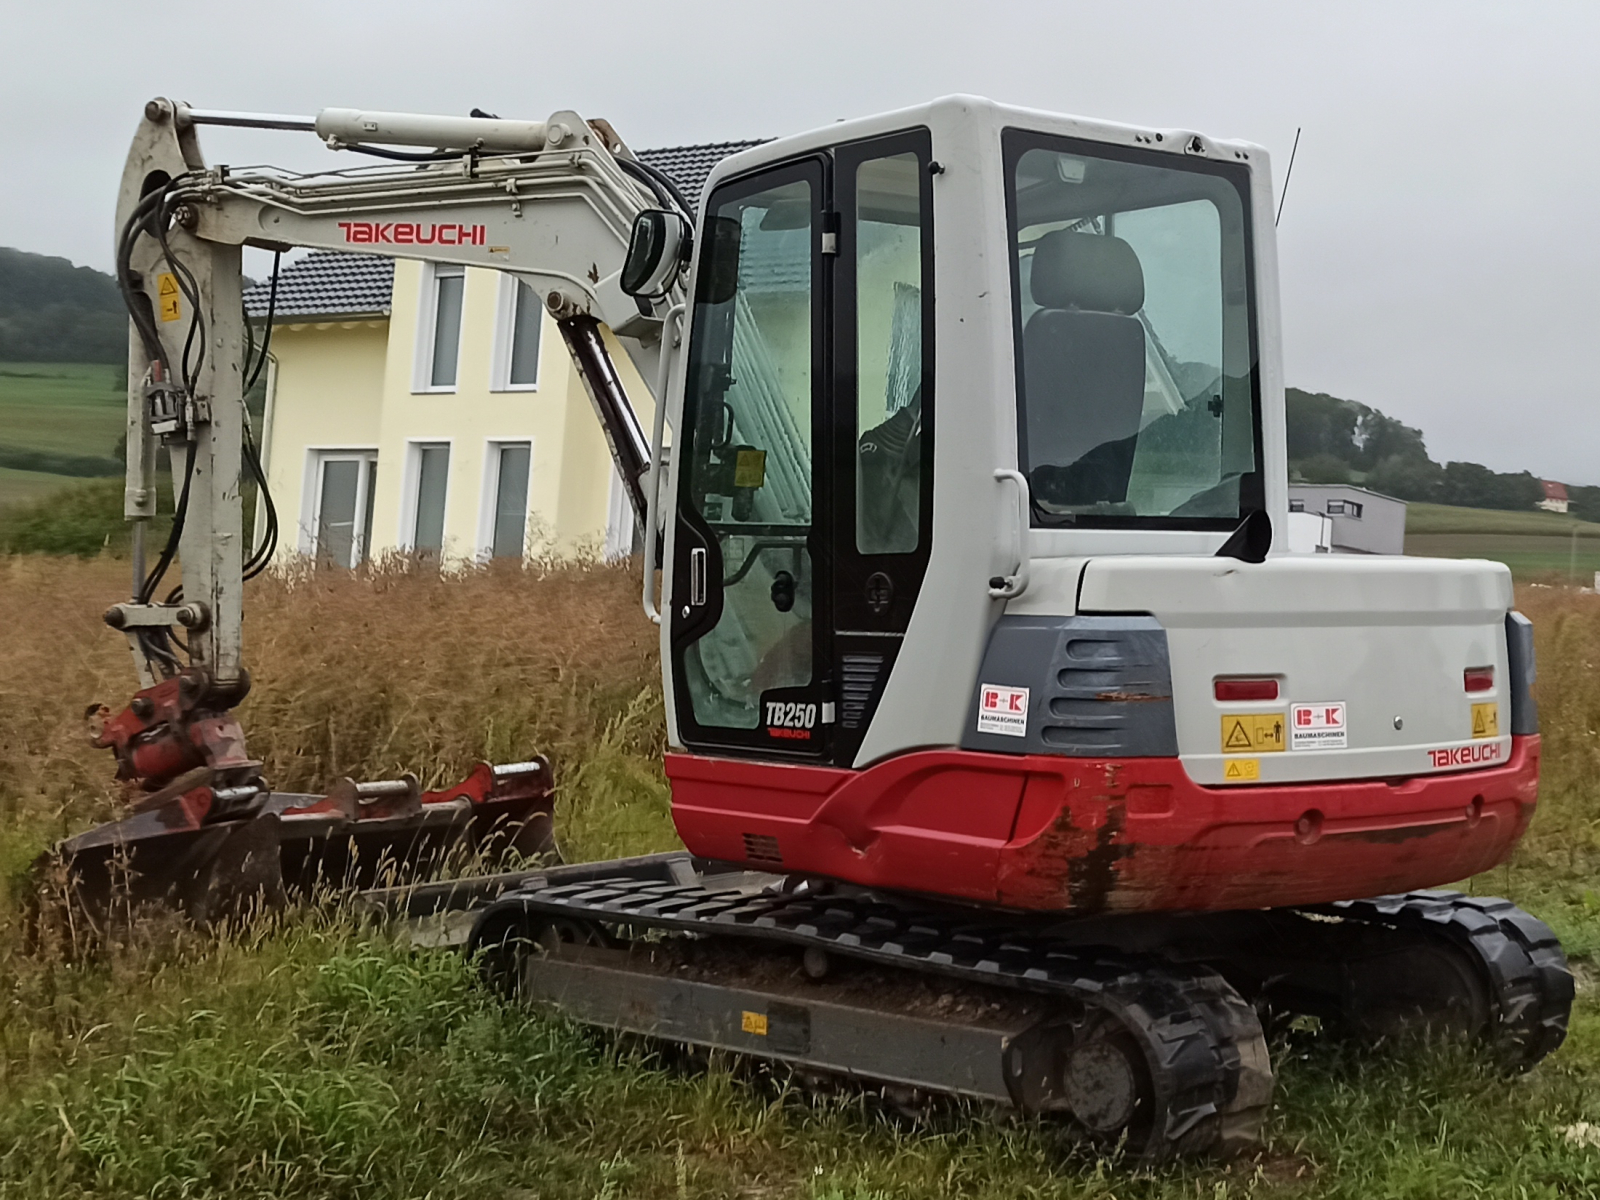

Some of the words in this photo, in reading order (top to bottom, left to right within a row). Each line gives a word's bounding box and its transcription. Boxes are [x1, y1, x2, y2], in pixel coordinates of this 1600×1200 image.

[766, 702, 816, 728] TB250
[980, 714, 1025, 725] BAUMASCHINEN
[1294, 731, 1345, 739] BAUMASCHINEN
